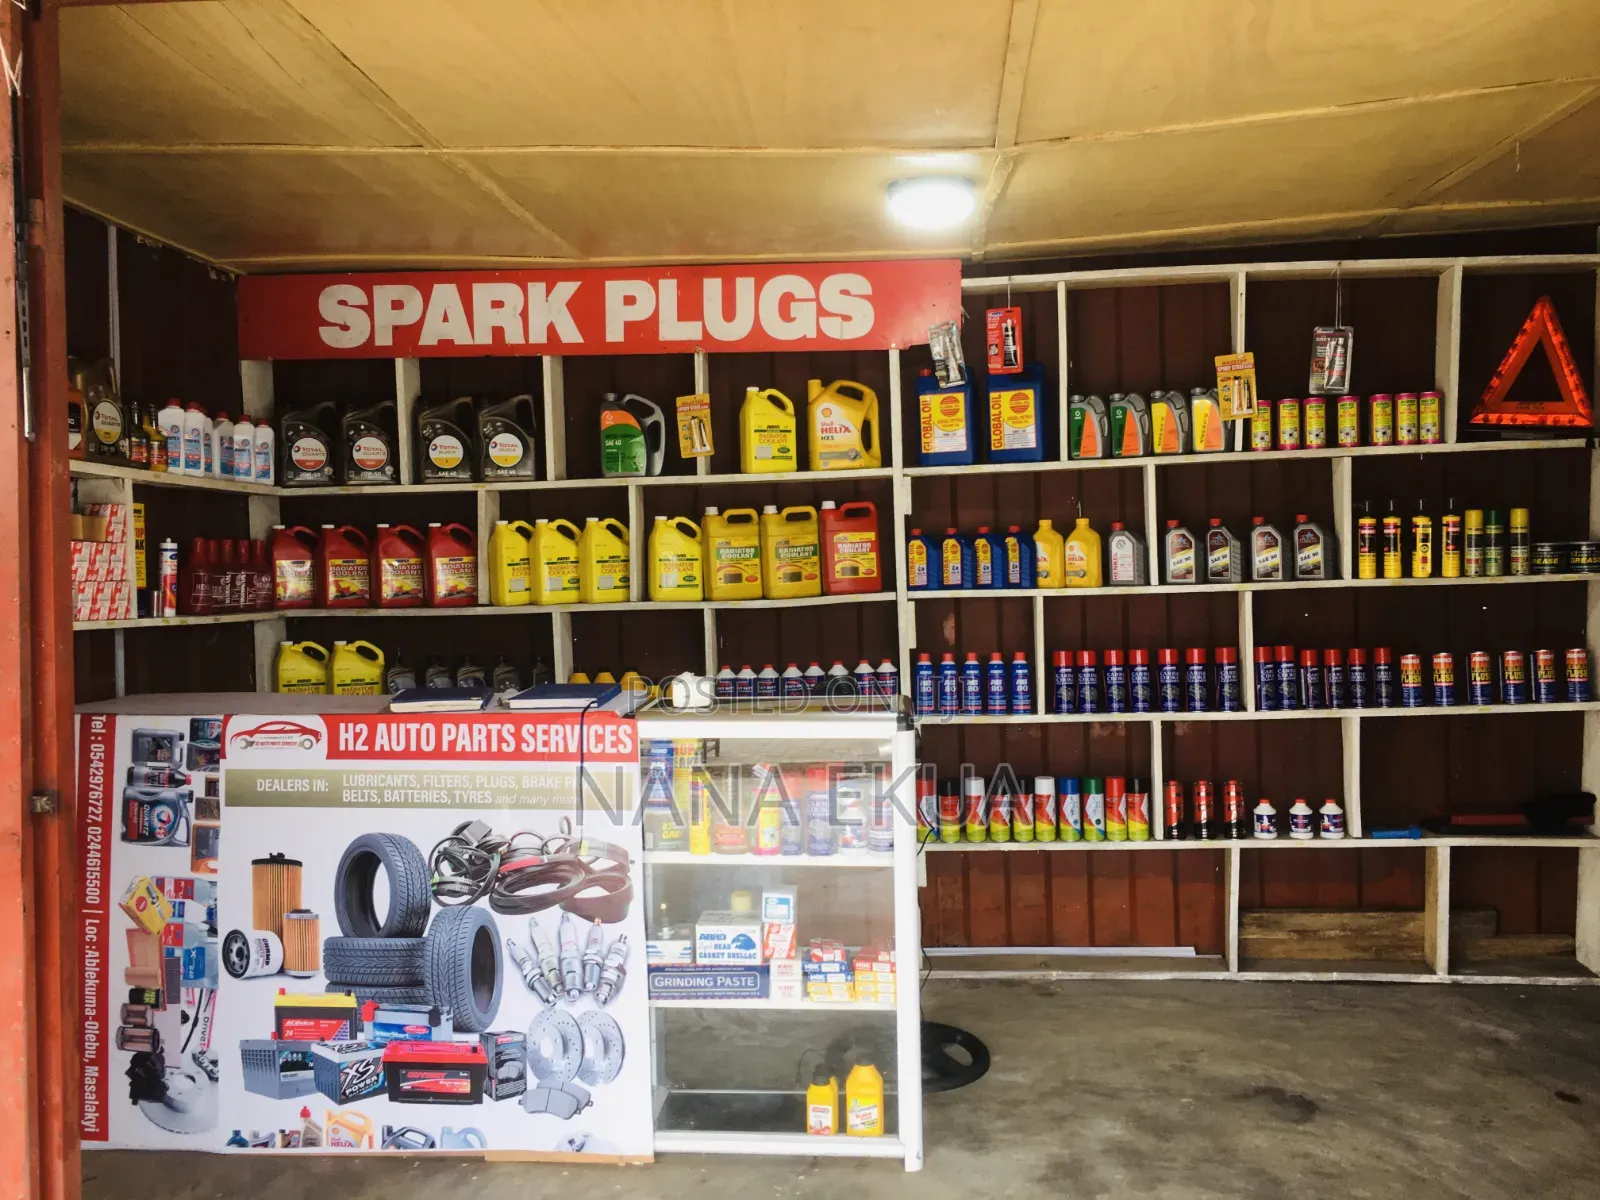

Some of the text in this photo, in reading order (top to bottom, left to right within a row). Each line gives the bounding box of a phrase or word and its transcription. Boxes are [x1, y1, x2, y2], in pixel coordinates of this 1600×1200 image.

[318, 272, 876, 348] SPARK PLUGS
[100, 413, 119, 422] TOTAL
[921, 399, 933, 452] GLOBAL OIL
[991, 394, 1003, 449] GLOBAL OIL
[820, 425, 852, 434] HELIX
[1173, 558, 1184, 566] SAE
[1211, 556, 1221, 564] SAE
[1258, 556, 1270, 564] SAE
[1300, 554, 1312, 562] SAE
[91, 715, 107, 734] Tel
[339, 723, 633, 755] H2 AUTO PARTS SERVICES
[87, 742, 105, 823] 0542976727,
[256, 778, 329, 792] DEALERS IN:
[342, 774, 561, 790] LUBRICANTS, FILTERS, PLUGS, BRAKE
[343, 790, 381, 804] BELTS,
[384, 790, 452, 804] BATTERIES,
[454, 790, 493, 804] TYRES
[494, 794, 516, 805] and
[519, 795, 549, 807] many
[85, 826, 102, 905] 0244615500
[85, 918, 101, 942] Loc
[699, 933, 727, 941] ABRO
[655, 976, 755, 987] GRINDING PASTE
[345, 1075, 379, 1096] POWER
[80, 1064, 98, 1132] Masalakyi
